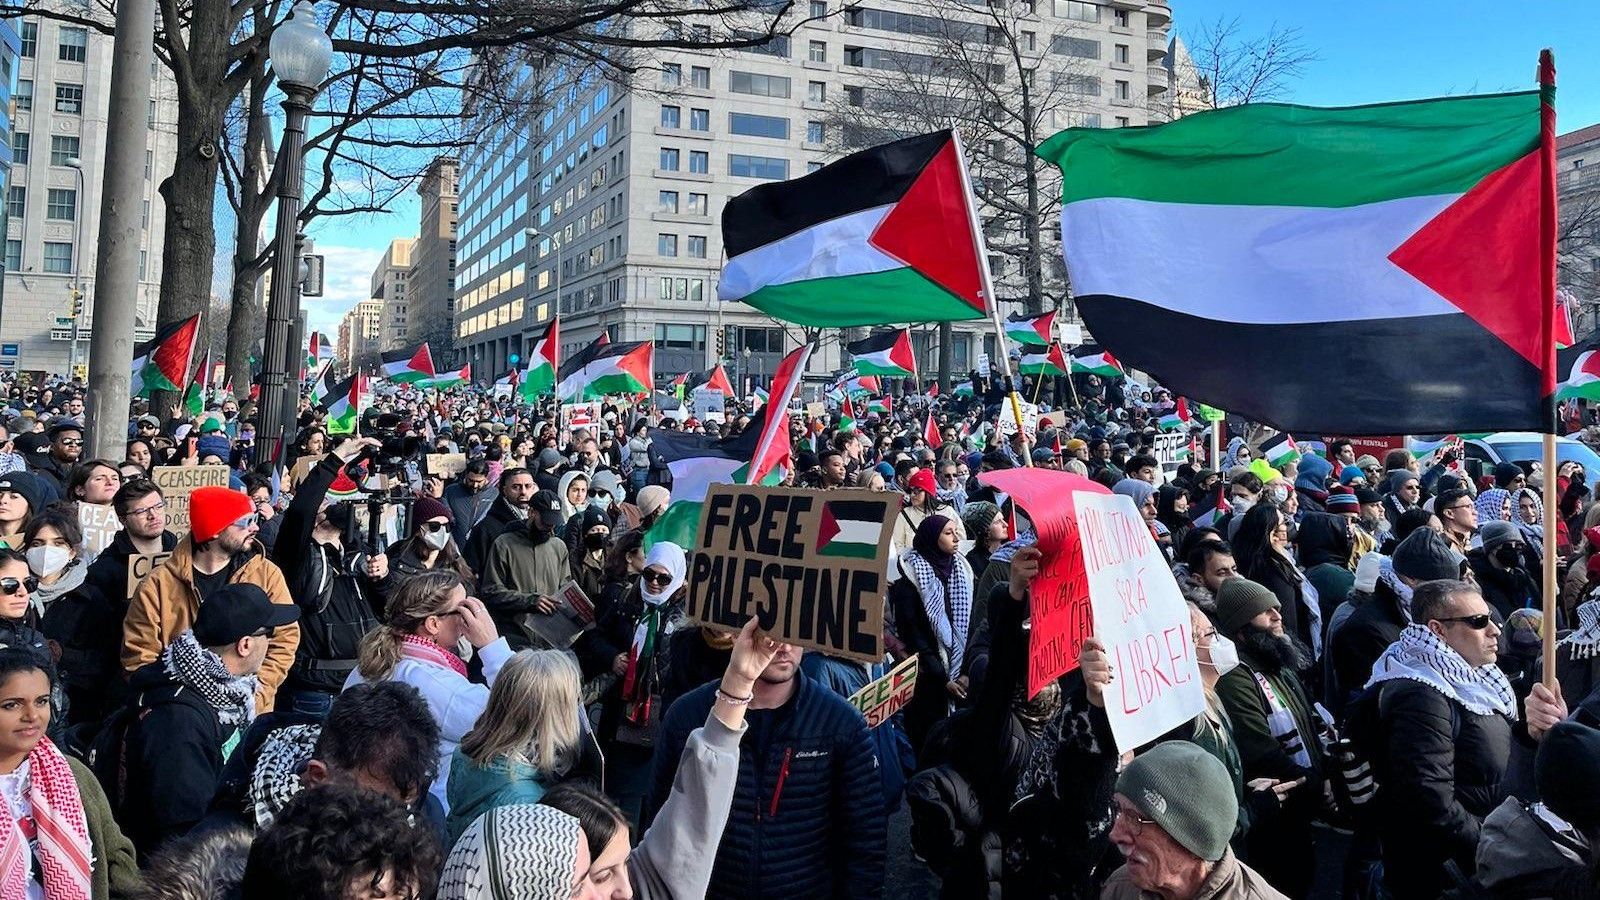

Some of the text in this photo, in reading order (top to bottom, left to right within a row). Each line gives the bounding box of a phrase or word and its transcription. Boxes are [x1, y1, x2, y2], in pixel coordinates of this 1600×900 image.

[1362, 439, 1389, 448] RENTALS
[158, 469, 227, 488] CEASEFIRE
[81, 504, 125, 530] CEA
[703, 493, 814, 560] FREE
[133, 554, 172, 579] CE
[688, 552, 880, 656] PALESTINE
[1115, 623, 1192, 715] LIBRE!
[865, 682, 914, 728] STINE
